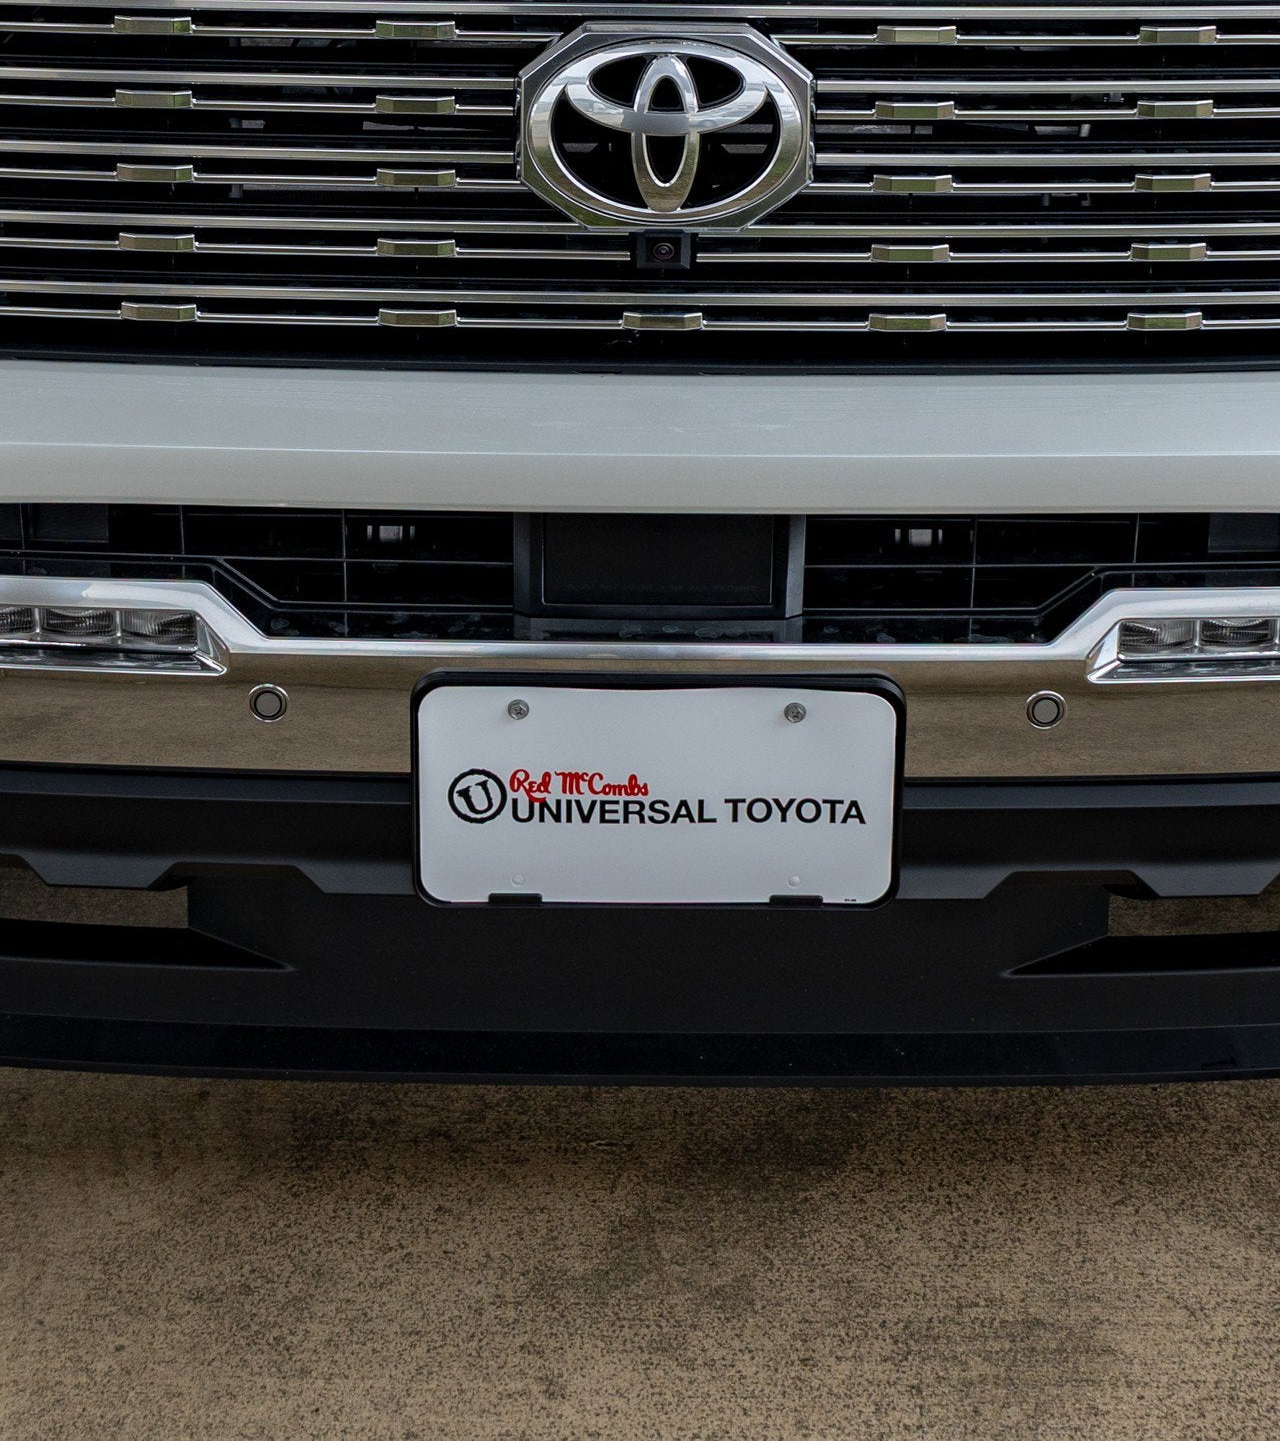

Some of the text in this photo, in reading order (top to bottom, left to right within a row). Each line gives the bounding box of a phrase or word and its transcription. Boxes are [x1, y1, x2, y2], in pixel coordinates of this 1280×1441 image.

[509, 769, 650, 803] Red McCombs
[511, 797, 867, 825] UNIVERSAL TOYOTA
